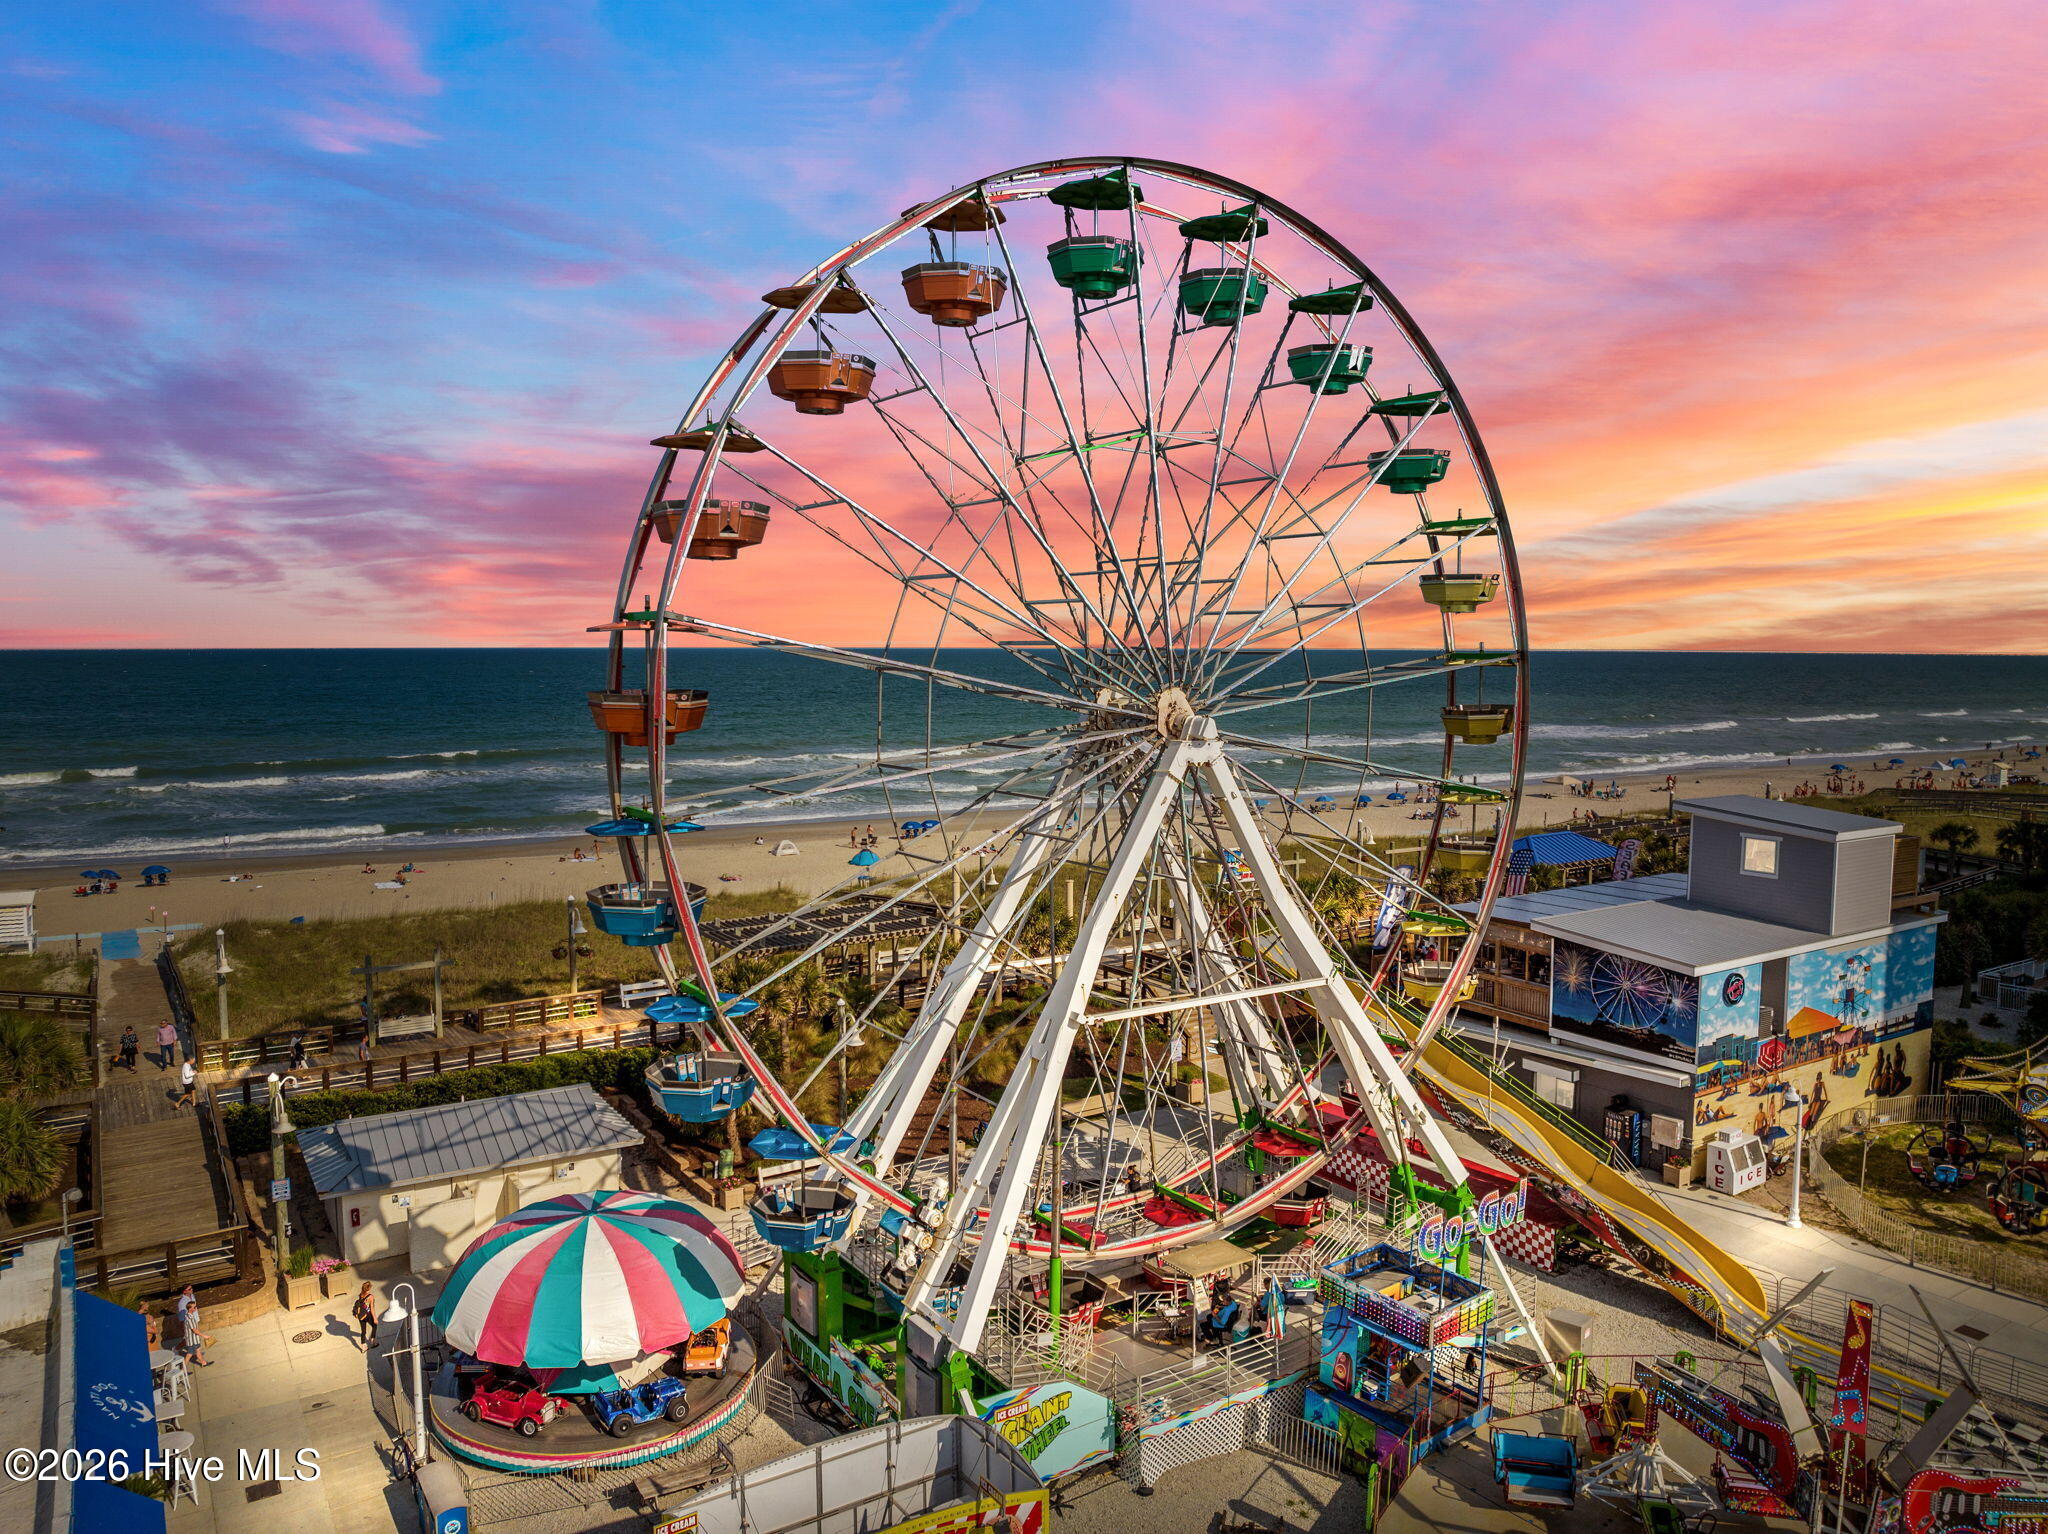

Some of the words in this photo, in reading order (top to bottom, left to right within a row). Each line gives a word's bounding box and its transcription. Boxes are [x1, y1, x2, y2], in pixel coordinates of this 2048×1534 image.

[1714, 1150, 1725, 1189] ICE
[1739, 1166, 1762, 1185] ICE
[997, 1411, 1007, 1421] ICE
[1007, 1402, 1028, 1417] CREAM
[1000, 1390, 1072, 1447] GIANT
[1019, 1415, 1070, 1465] WHEEL
[670, 1515, 696, 1532] CREAM
